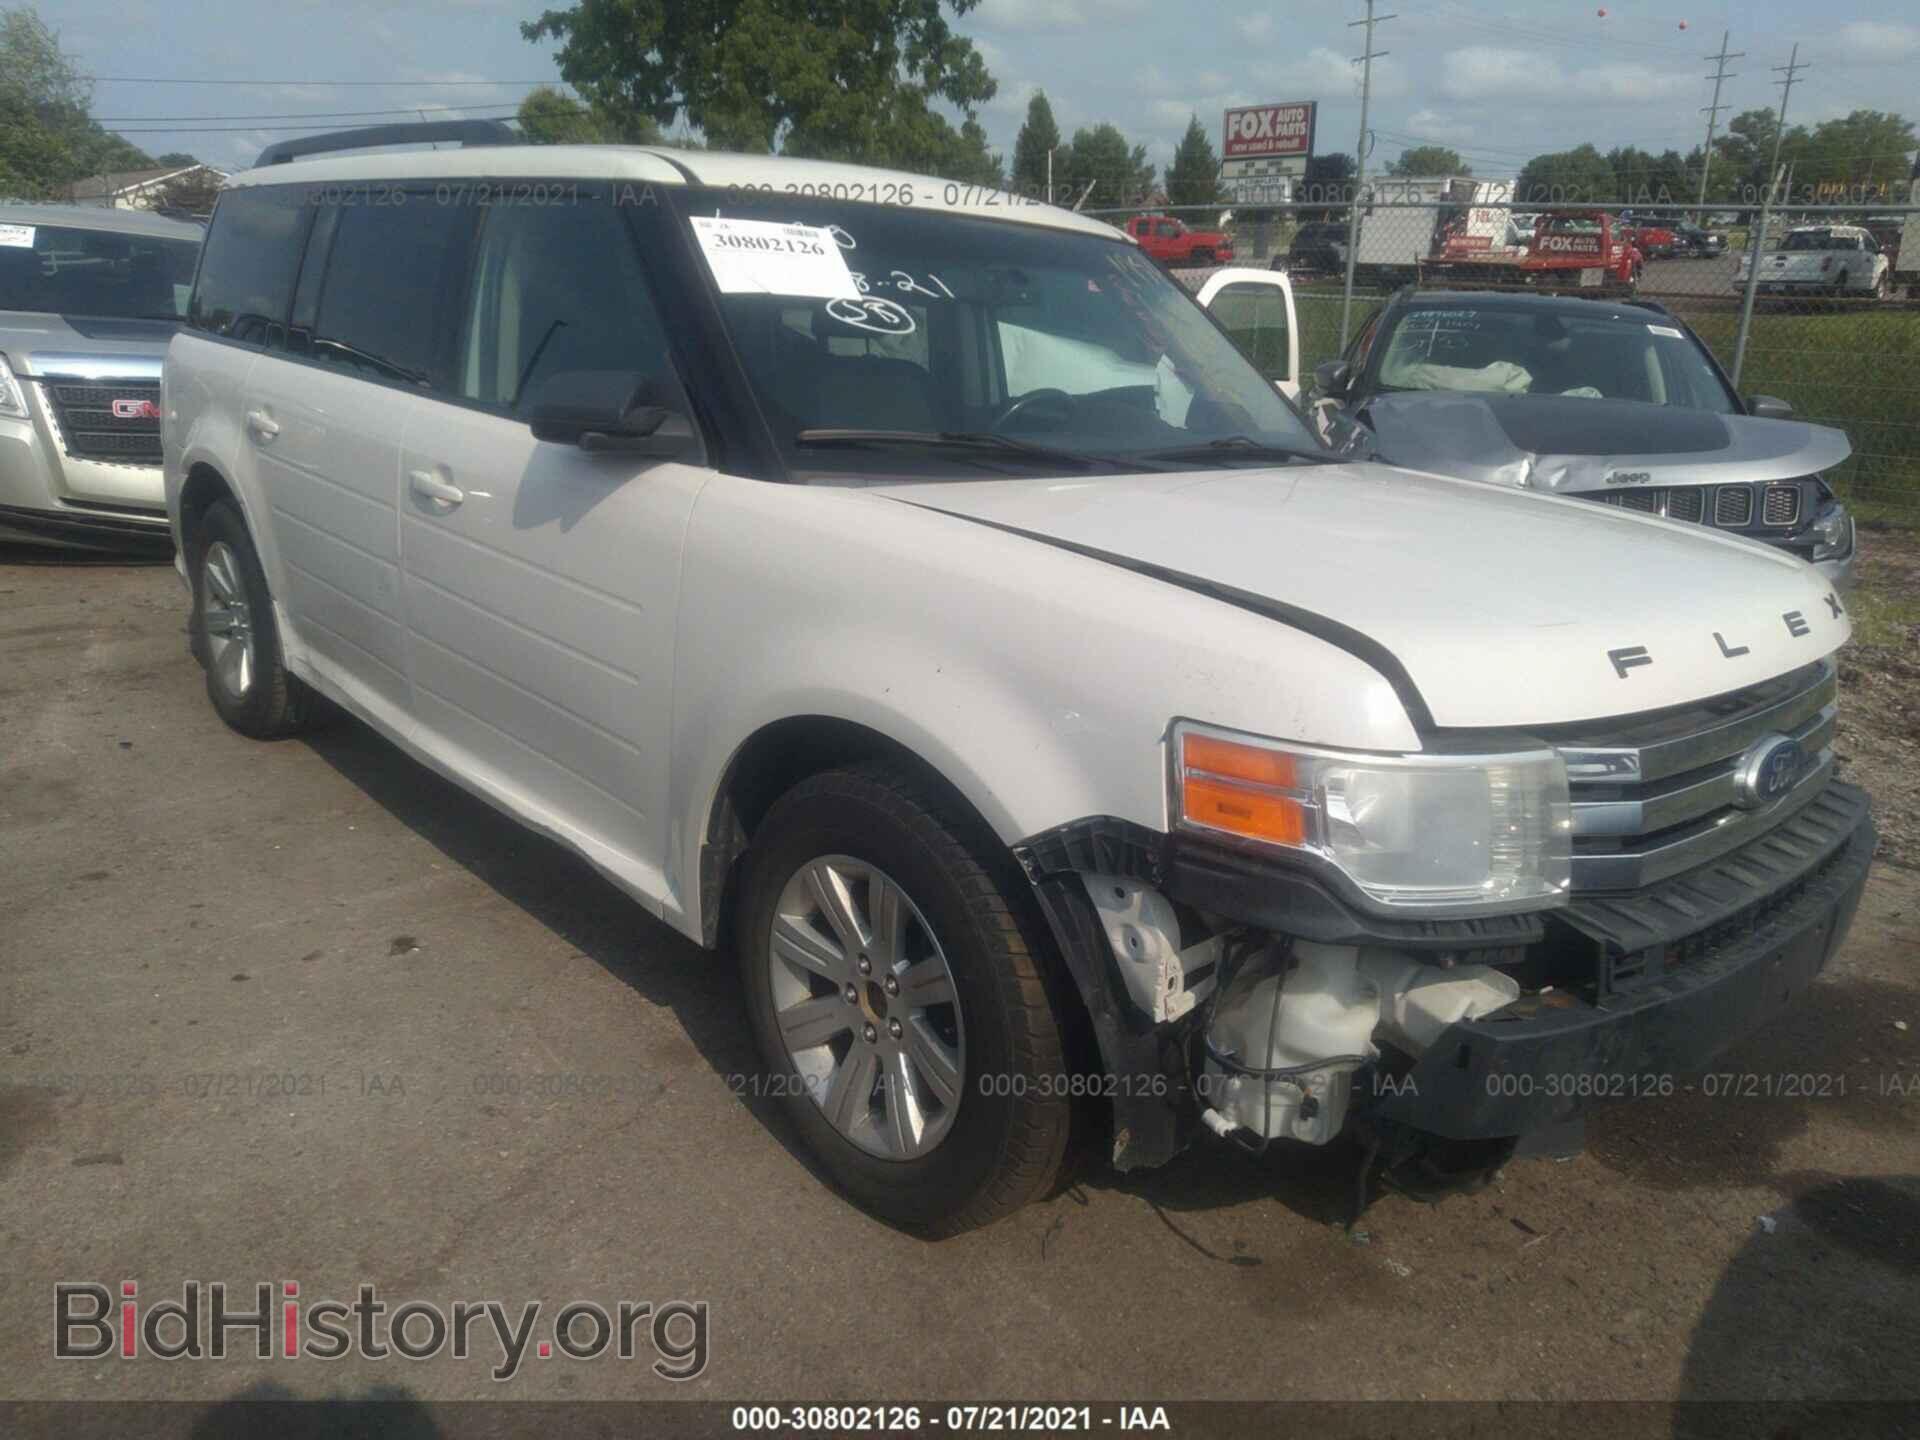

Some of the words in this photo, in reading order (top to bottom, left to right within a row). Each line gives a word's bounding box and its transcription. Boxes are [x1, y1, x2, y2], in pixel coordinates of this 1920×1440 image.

[1277, 108, 1304, 122] AUTO
[1228, 111, 1274, 140] FOX
[1276, 122, 1306, 136] PARTS
[713, 233, 825, 256] 30802126
[1539, 236, 1574, 251] FOX
[1573, 245, 1599, 253] PARTS
[112, 399, 161, 418] GM
[1605, 470, 1651, 485] Jeep
[1607, 592, 1843, 680] FLEX
